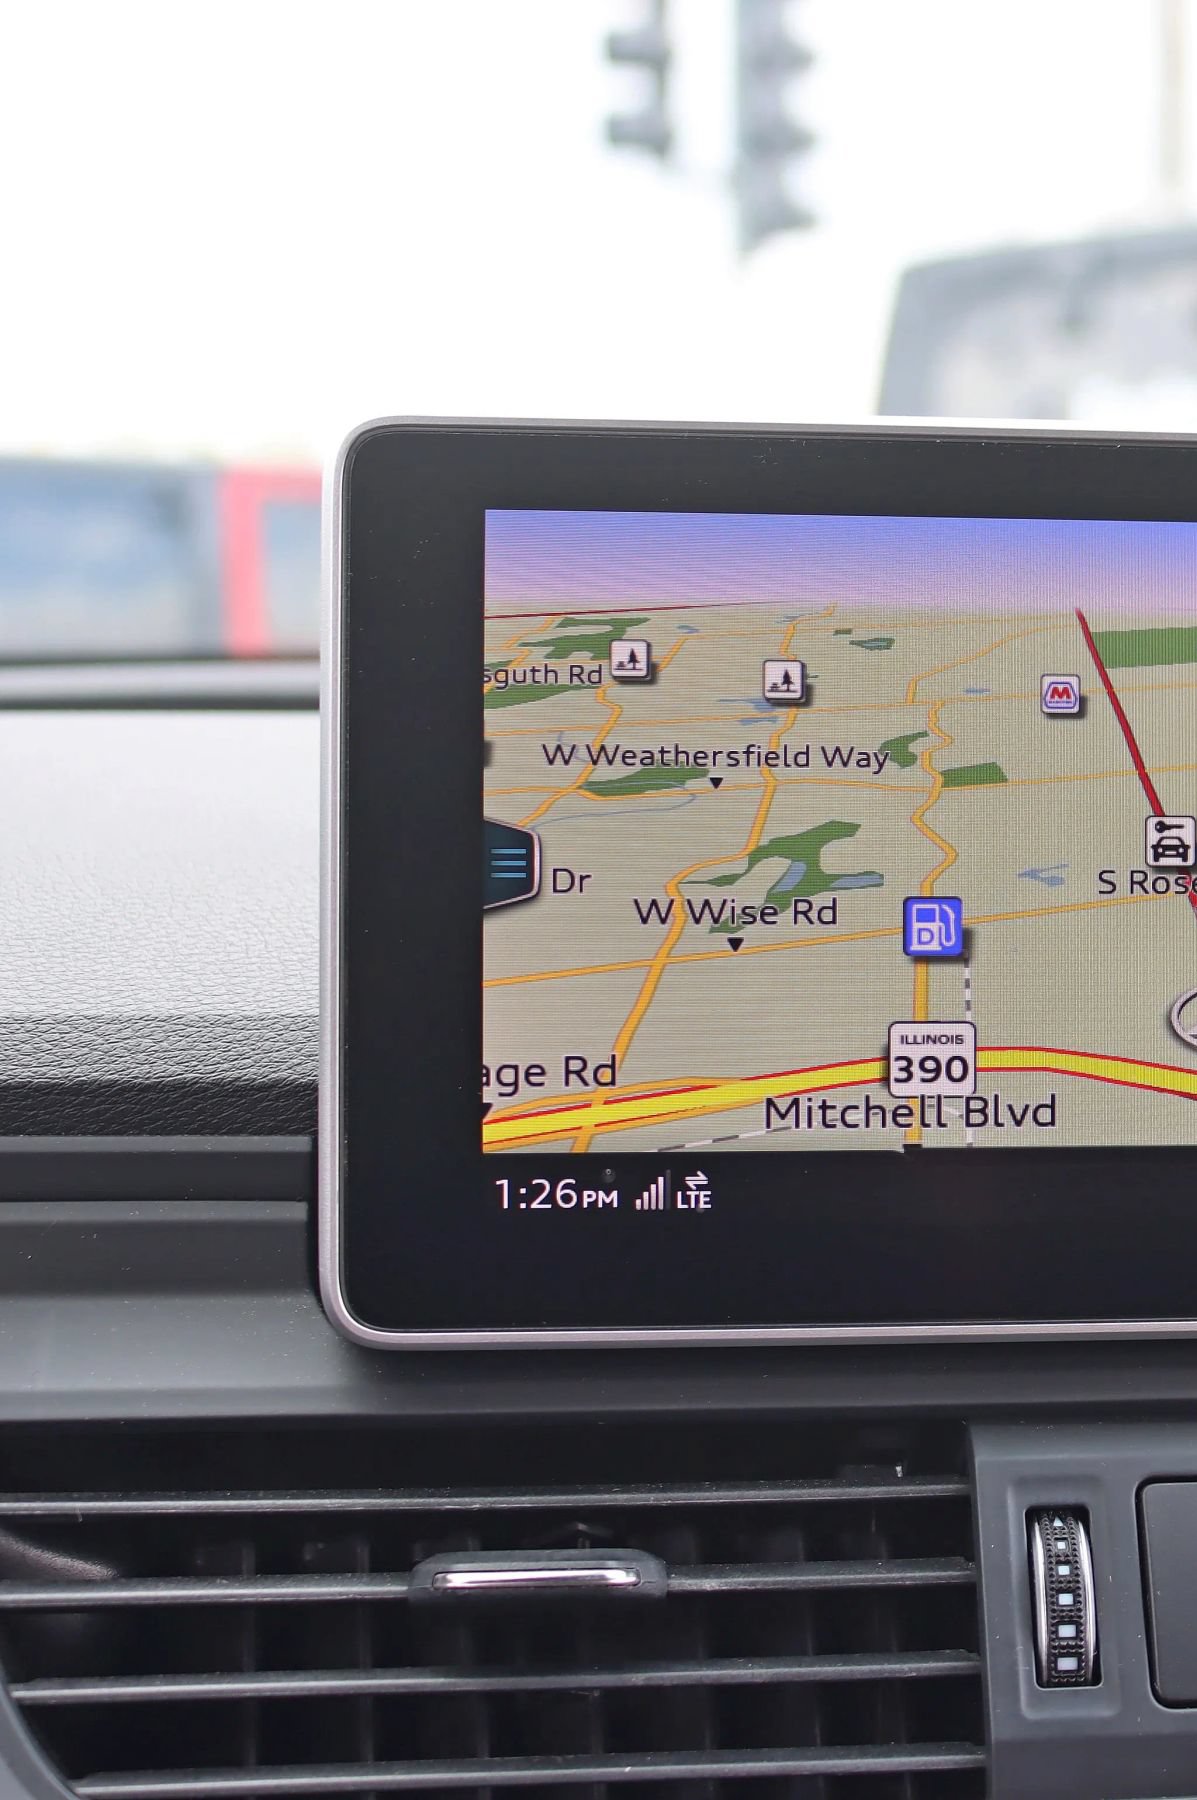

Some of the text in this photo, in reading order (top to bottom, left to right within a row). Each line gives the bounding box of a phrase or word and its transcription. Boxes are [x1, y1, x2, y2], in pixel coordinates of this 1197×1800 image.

[569, 664, 603, 685] Rd
[543, 743, 891, 773] W Weathersfield Way
[552, 868, 592, 893] Dr
[1098, 871, 1117, 895] S
[634, 897, 838, 925] W Wise Rd
[900, 1034, 965, 1046] ILLINOIS
[563, 1055, 618, 1087] Rd
[893, 1057, 969, 1084] 390
[765, 1094, 1057, 1130] Mitchell Blvd
[677, 1190, 712, 1209] LTE
